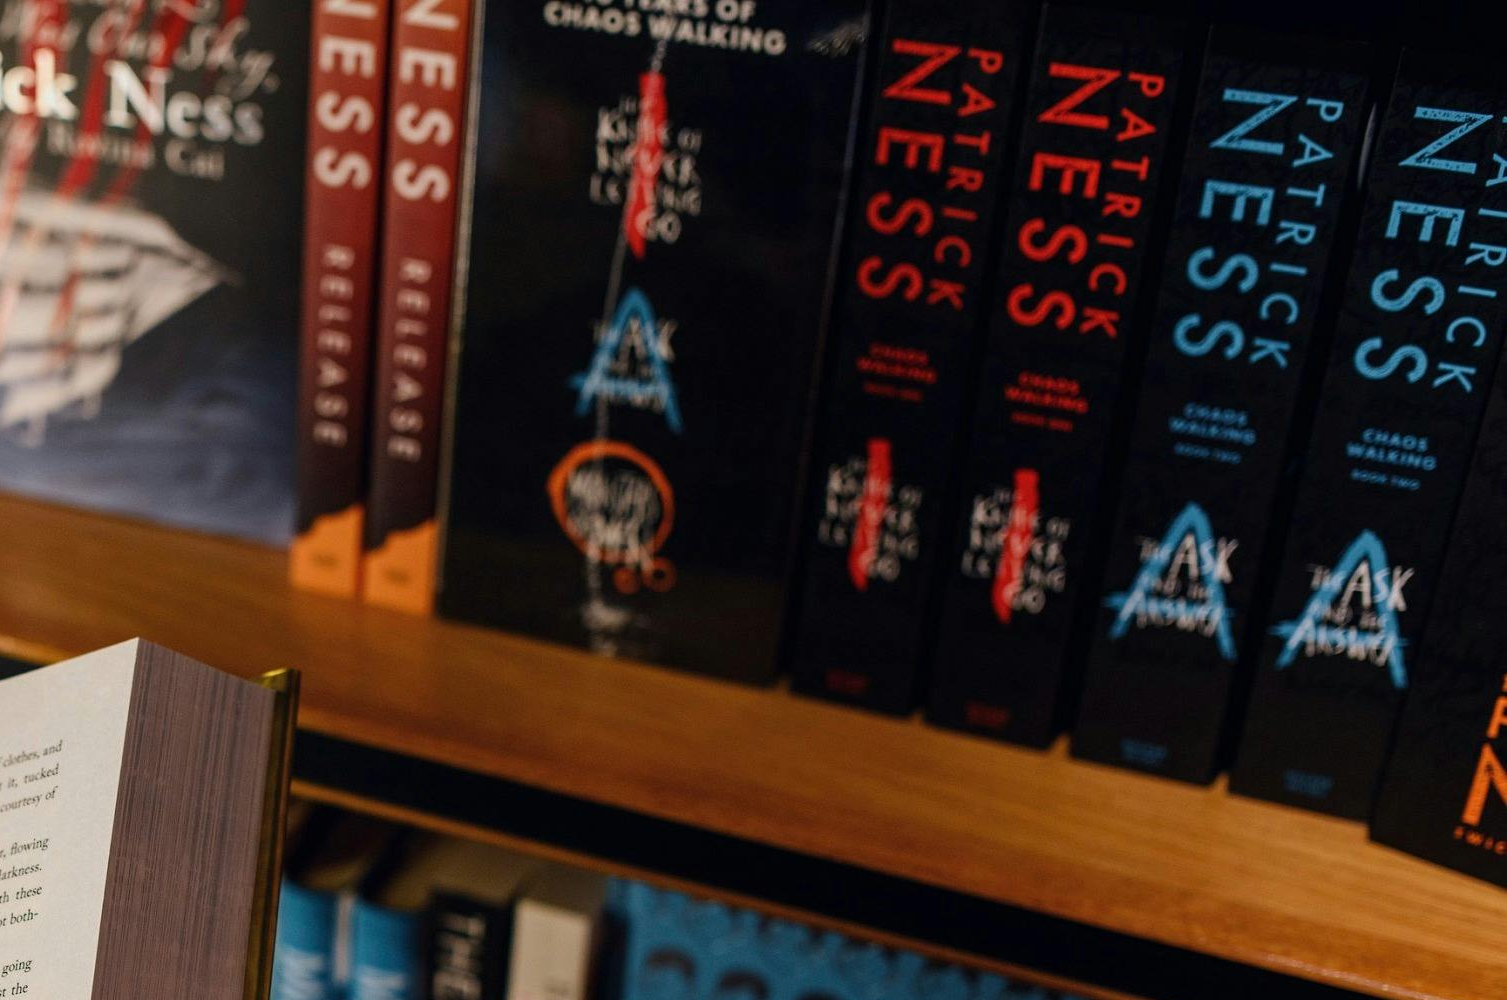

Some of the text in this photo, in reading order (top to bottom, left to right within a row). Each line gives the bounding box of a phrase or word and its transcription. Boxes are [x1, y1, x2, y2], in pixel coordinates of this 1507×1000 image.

[544, 1, 642, 37] CHAOS
[648, 14, 786, 55] WALKING
[715, 0, 756, 22] OF
[104, 60, 266, 146] Ness
[855, 38, 962, 302] NESS
[926, 47, 1003, 310] PATRICK
[1005, 61, 1122, 330] NESS
[1079, 70, 1165, 338] PATRICK
[1173, 88, 1298, 360] NESS
[1248, 97, 1344, 368] PATRICK
[1353, 106, 1493, 384] NESS
[313, 244, 356, 448] RELEASE
[387, 257, 433, 462] RELEASE
[1183, 403, 1248, 426] CHAOS
[1168, 417, 1256, 446] WALKING
[1346, 442, 1437, 471] WALKING
[1362, 428, 1428, 453] CHAOS
[1339, 559, 1414, 613] ASK
[2, 957, 32, 980] going
